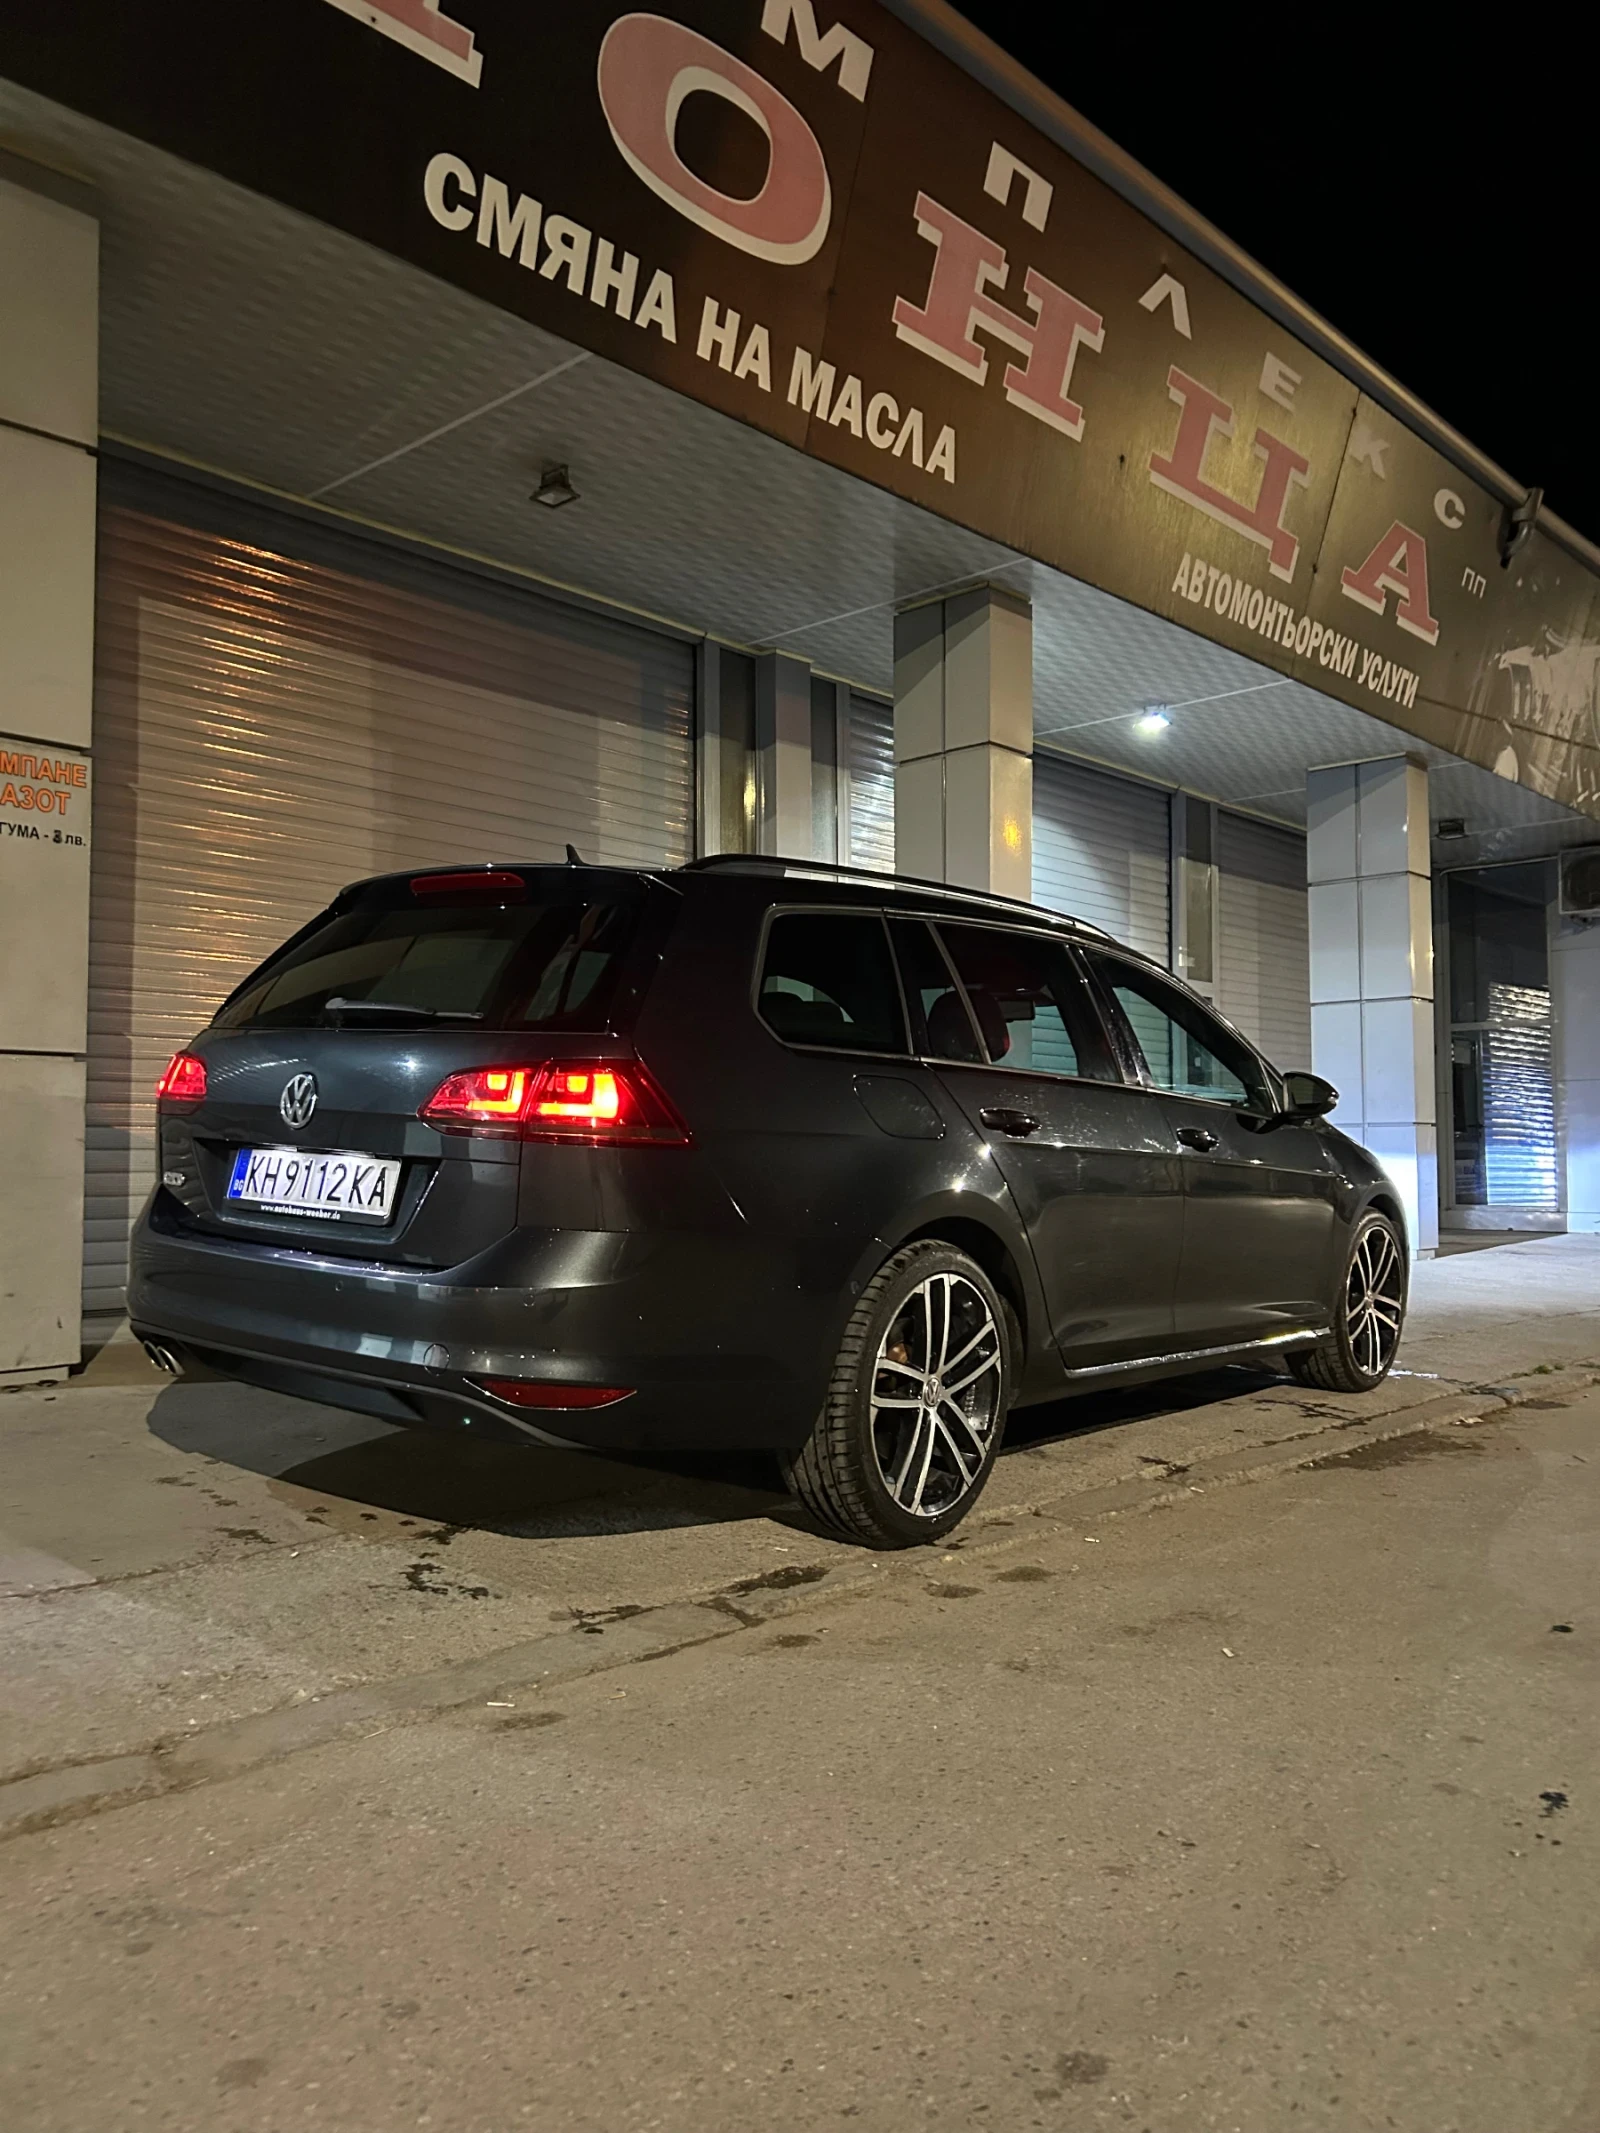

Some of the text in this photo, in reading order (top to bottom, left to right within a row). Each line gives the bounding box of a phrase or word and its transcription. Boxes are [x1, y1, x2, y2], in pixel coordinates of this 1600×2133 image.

[424, 152, 956, 484] СМЯНА НА МАСЛА
[1171, 552, 1420, 709] АВТОМОНТЬОРСКИ УСЛУГИ
[0, 782, 71, 815] АЗОТ
